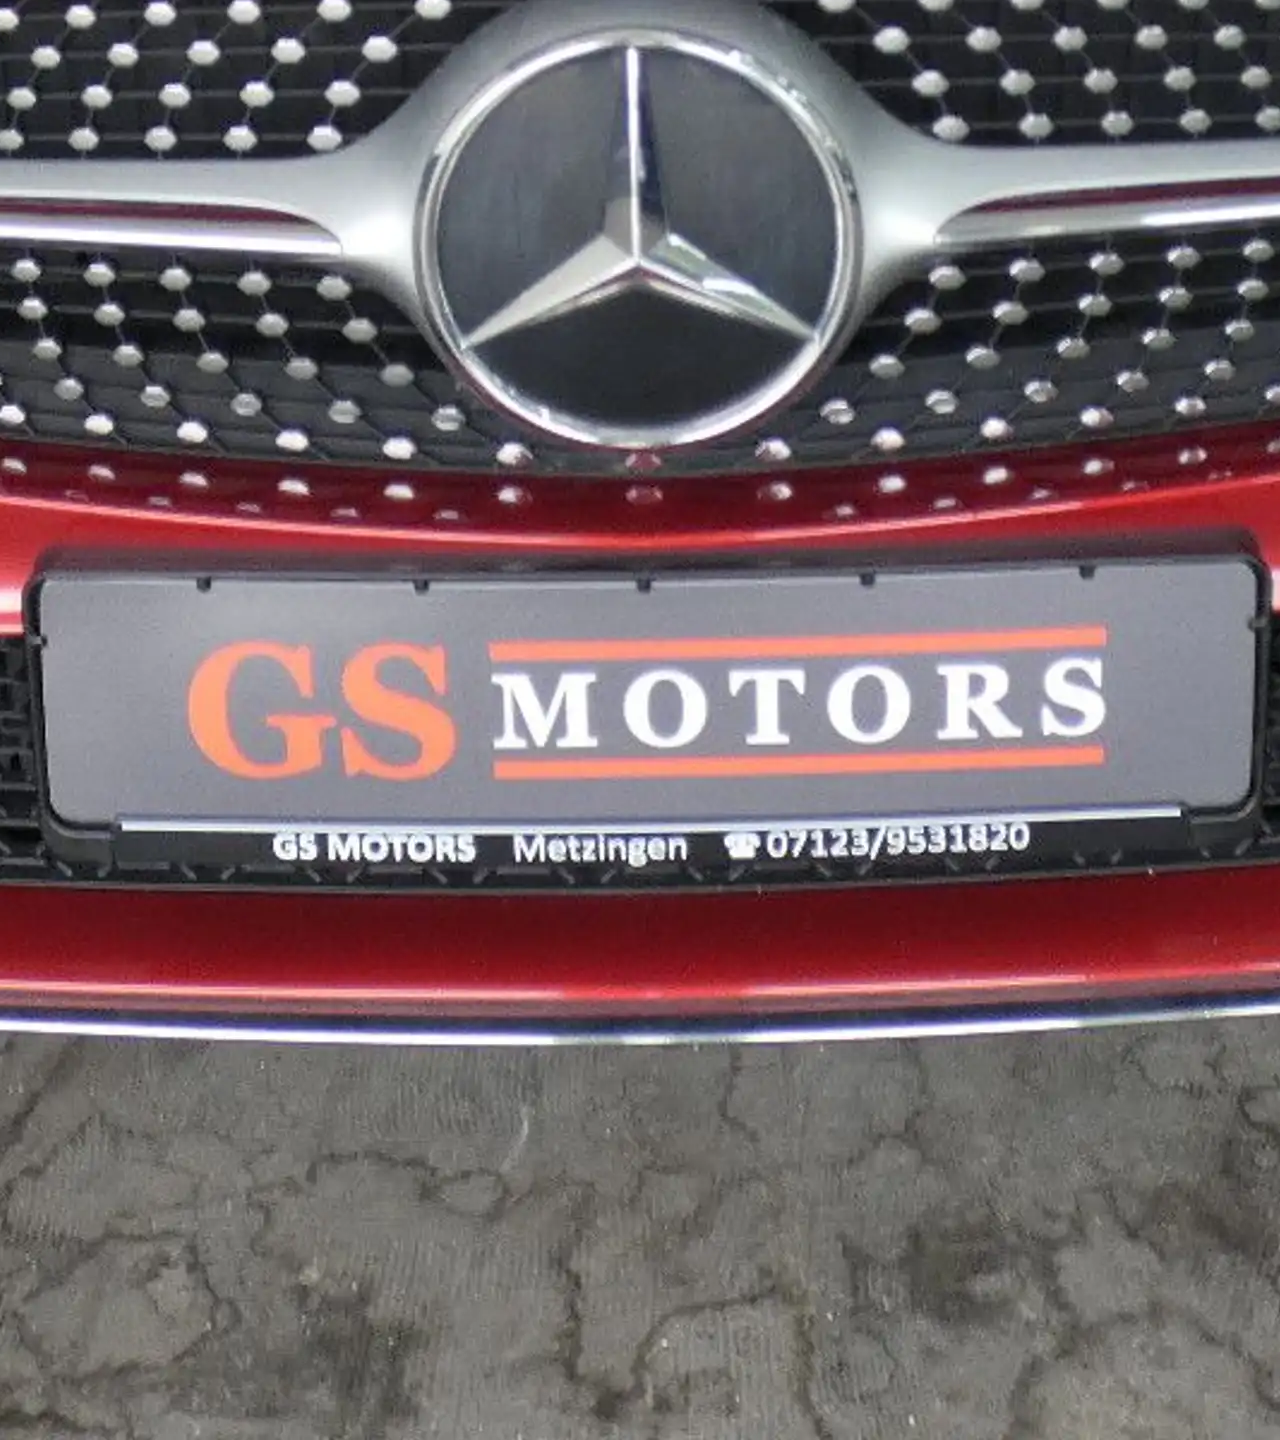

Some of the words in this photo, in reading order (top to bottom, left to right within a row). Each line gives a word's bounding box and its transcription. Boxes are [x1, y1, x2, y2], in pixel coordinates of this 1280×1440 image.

[187, 638, 458, 782] GS
[490, 656, 1107, 750] MOTORS
[272, 831, 318, 862] GS
[327, 831, 477, 863] MOTORS
[512, 832, 688, 868] Metzingen
[766, 821, 1031, 861] 07123/9531820
